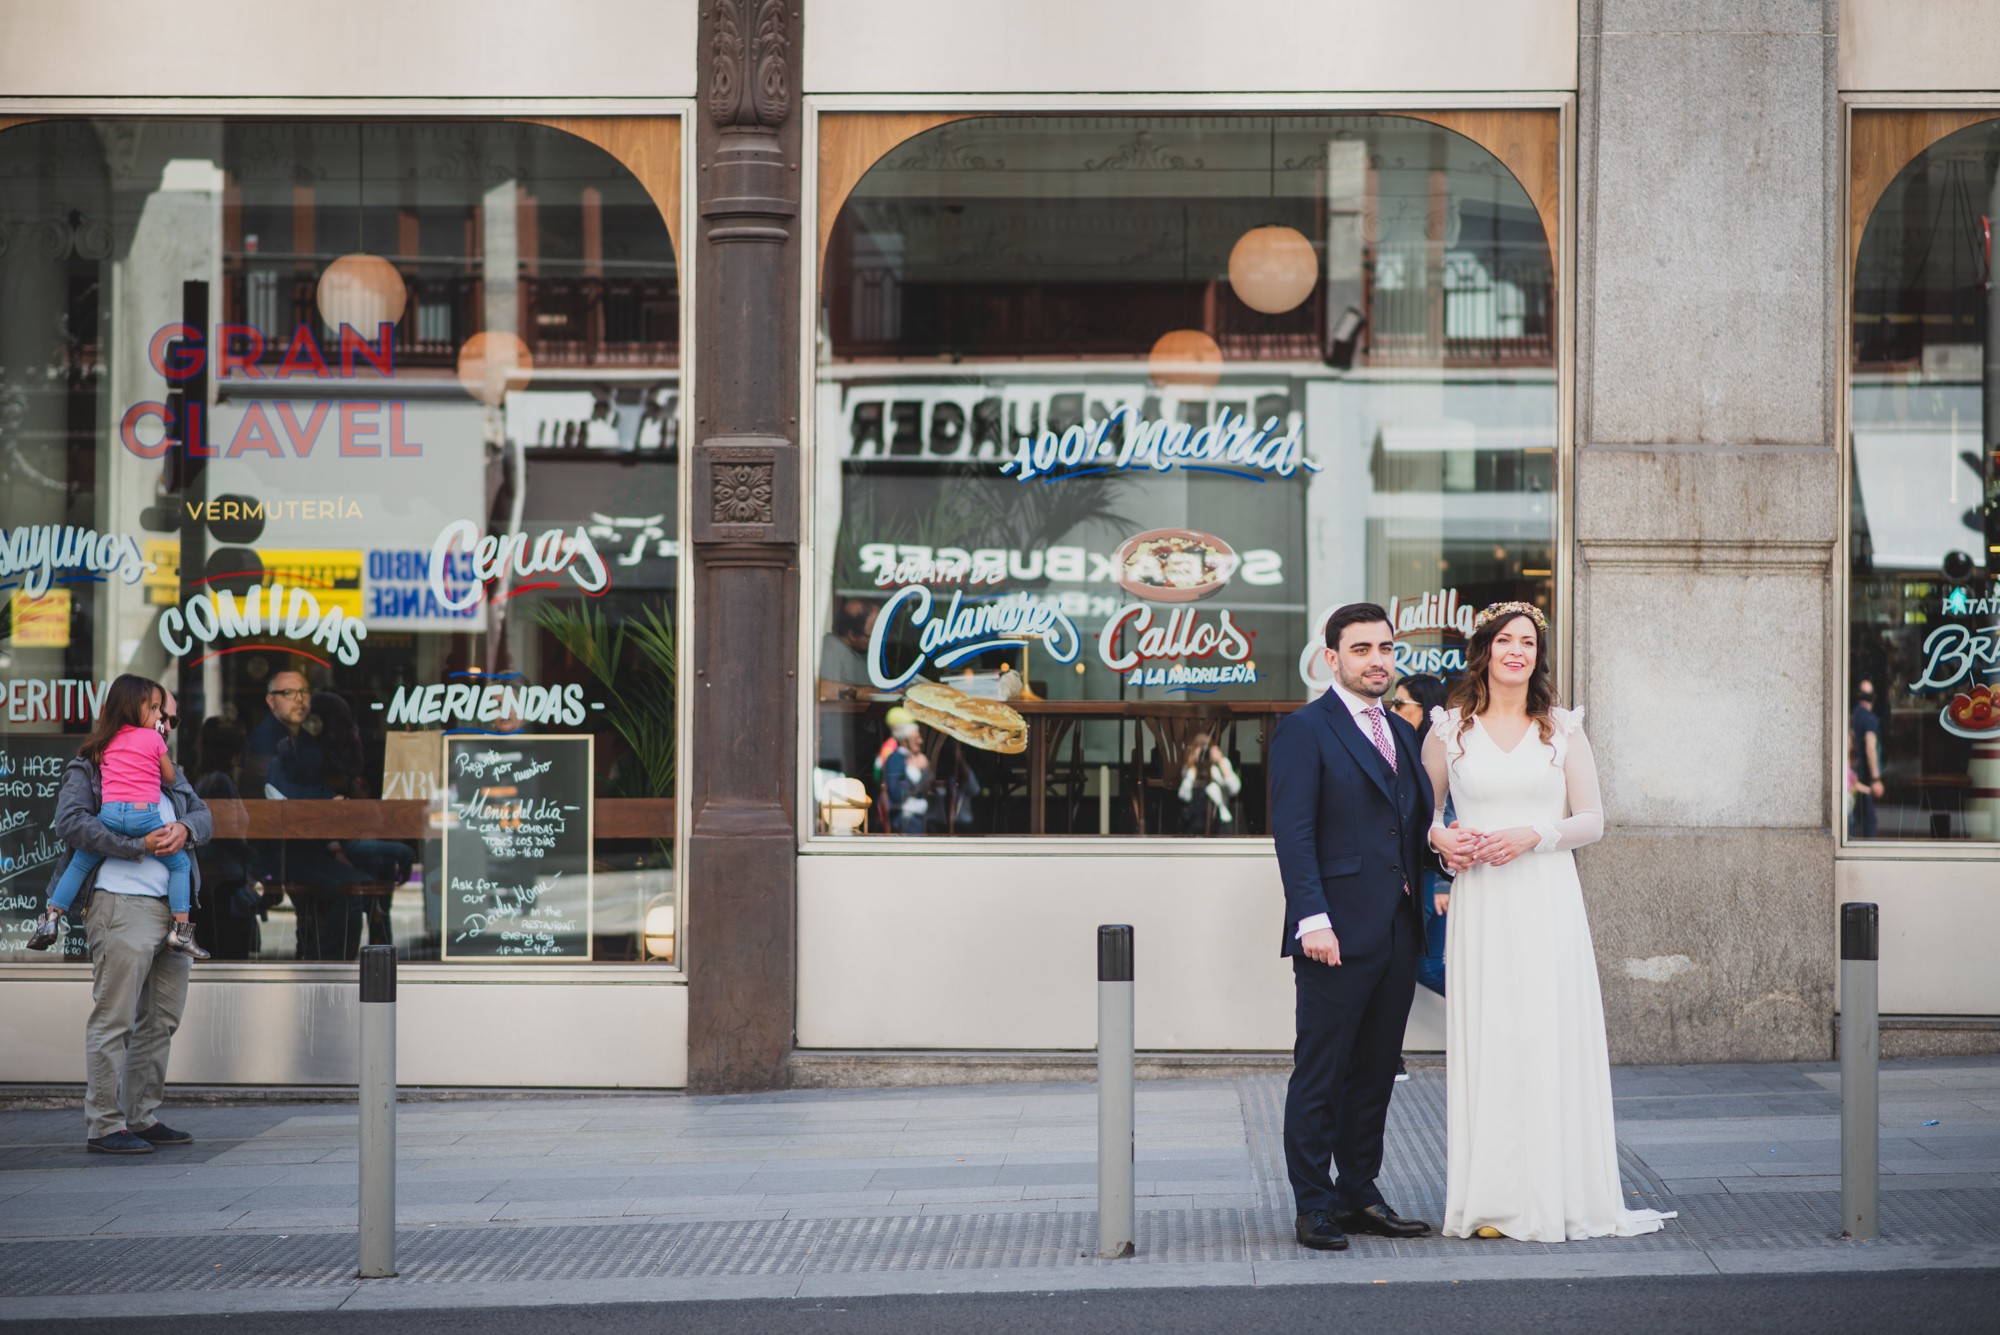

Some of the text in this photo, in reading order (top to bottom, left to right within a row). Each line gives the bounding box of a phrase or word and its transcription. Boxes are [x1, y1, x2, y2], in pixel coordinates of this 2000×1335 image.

[148, 322, 395, 381] GRAN
[120, 400, 423, 460] CLAVEL
[1015, 404, 1304, 482] 100% Madrid
[186, 496, 364, 521] VERMUTERÍA
[429, 519, 612, 613] Cenas
[159, 584, 367, 666] COMIDAS
[867, 584, 1081, 692] Calamares
[1098, 602, 1252, 672] Callos
[1128, 669, 1145, 687] A
[1145, 667, 1167, 686] LA
[1908, 623, 2000, 691] BR
[386, 683, 587, 727] MERIENDAS
[492, 762, 513, 782] por
[512, 798, 534, 820] del
[534, 797, 566, 821] día
[451, 877, 499, 893] Ask for
[462, 893, 488, 904] our
[501, 930, 556, 947] every day
